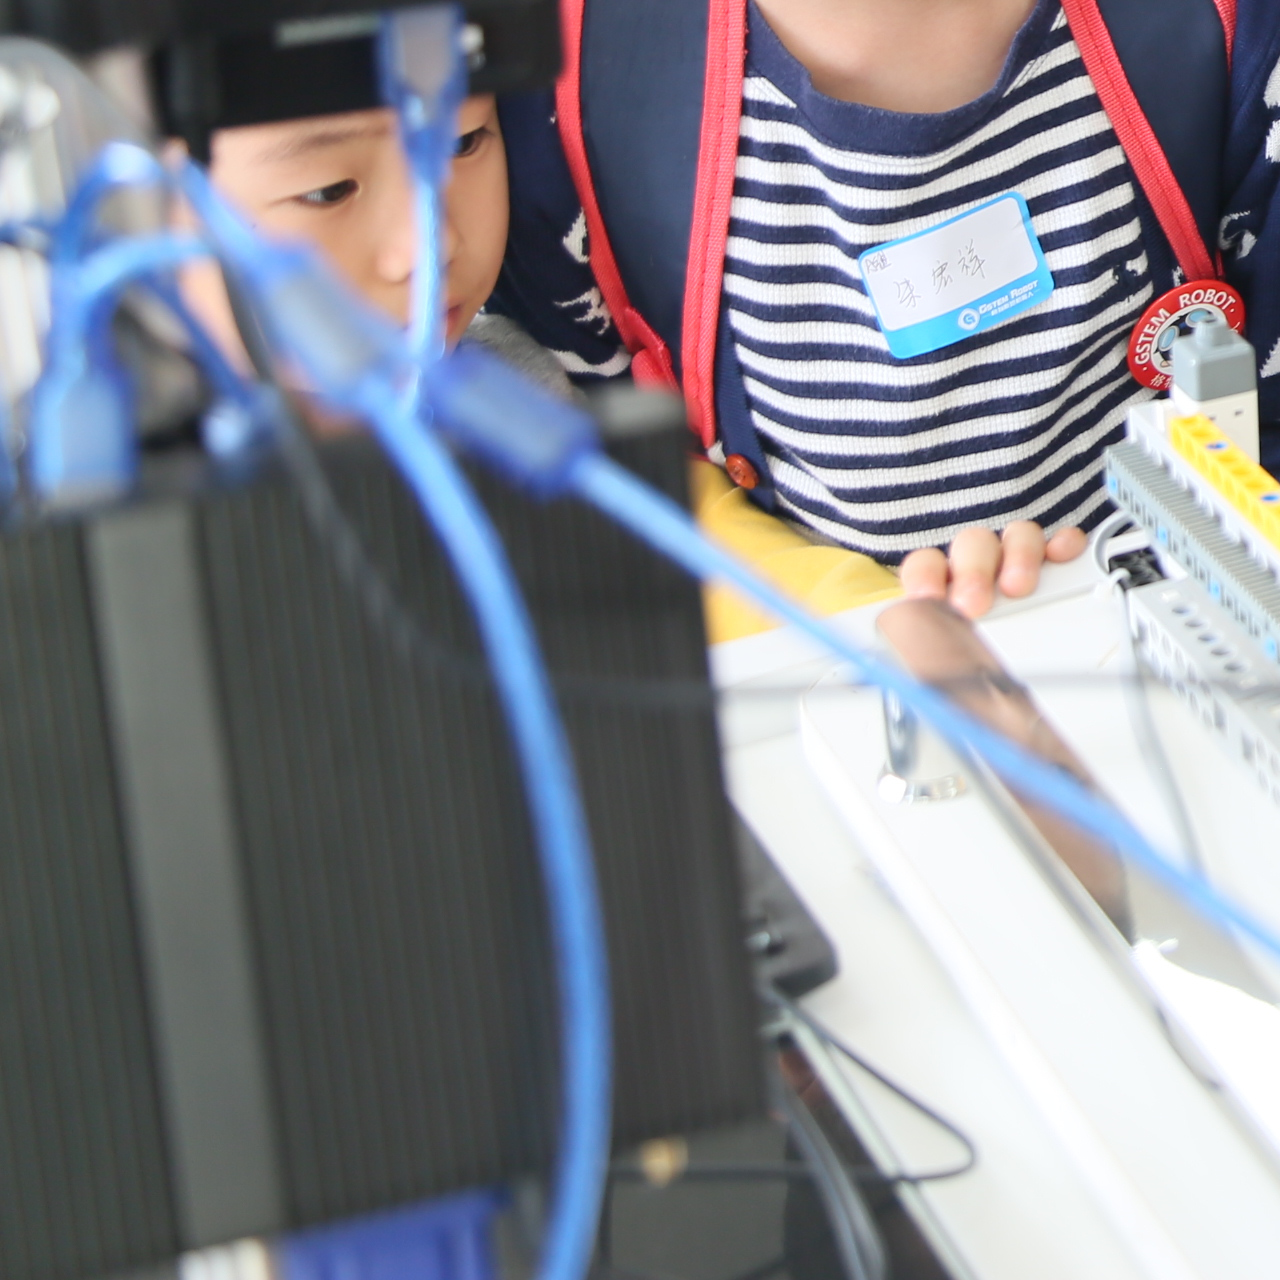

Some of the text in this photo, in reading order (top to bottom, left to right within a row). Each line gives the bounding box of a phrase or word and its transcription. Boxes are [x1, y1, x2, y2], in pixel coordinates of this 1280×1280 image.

[978, 295, 1009, 315] GSTEM
[1010, 279, 1038, 299] ROBOT
[1134, 288, 1236, 365] GSTEM ROBOT
